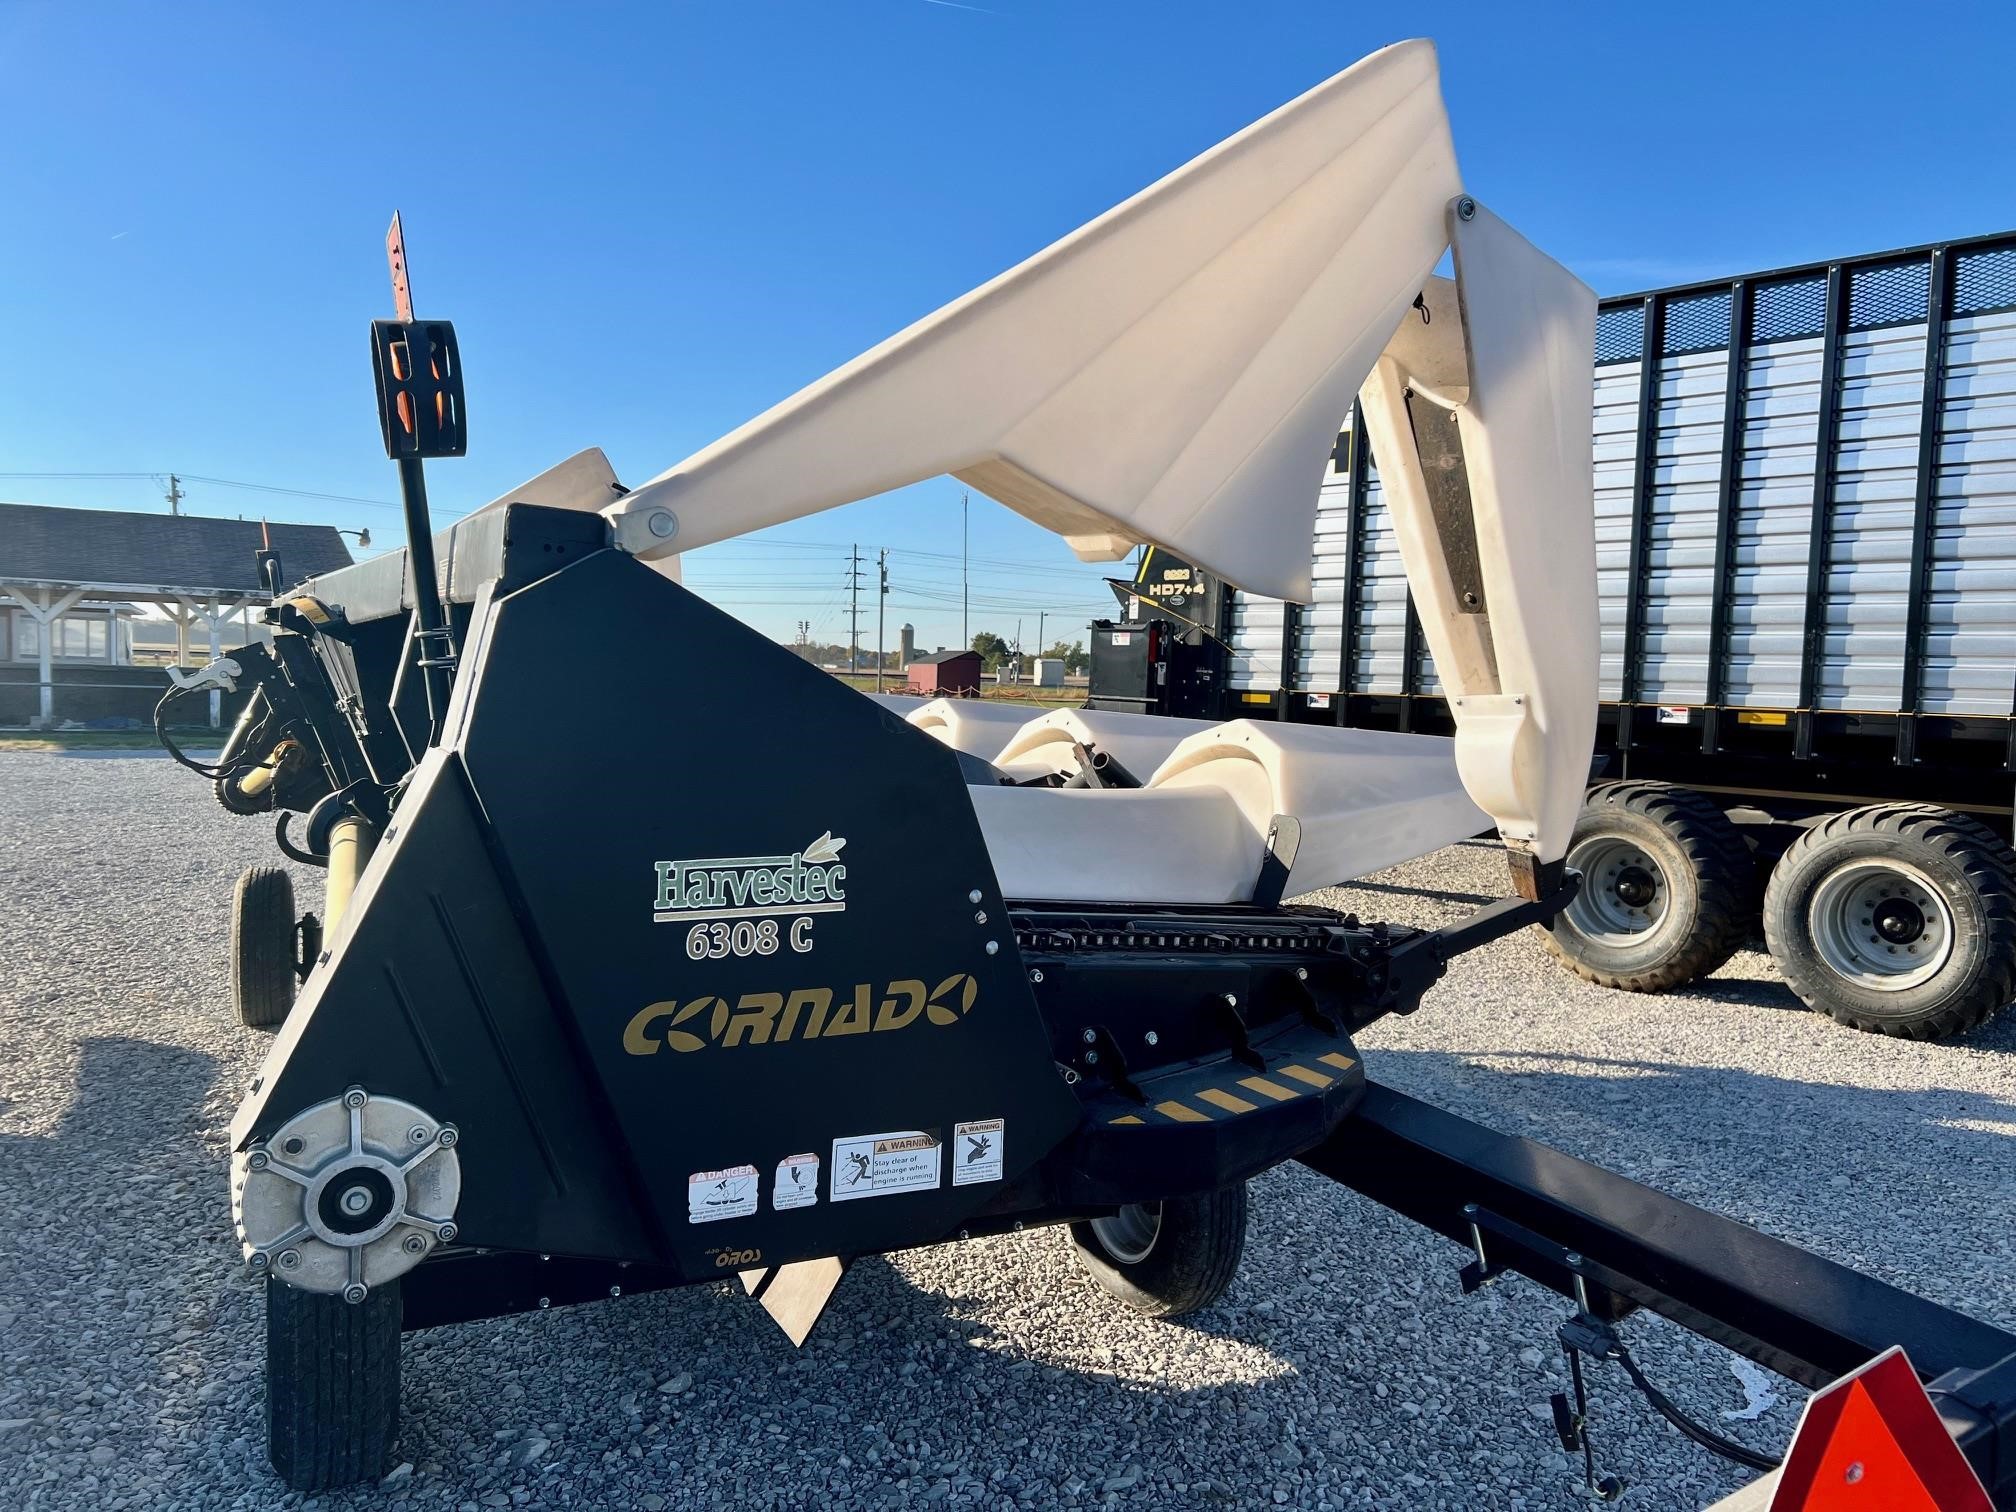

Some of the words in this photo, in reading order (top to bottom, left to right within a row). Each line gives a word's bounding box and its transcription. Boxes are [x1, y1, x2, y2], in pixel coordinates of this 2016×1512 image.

[1149, 583, 1205, 596] HD7+4
[654, 853, 846, 909] Harvestec
[686, 919, 779, 960] 6308
[790, 917, 814, 952] C
[622, 973, 978, 1056] CORNADO
[968, 1123, 1000, 1132] WARNING
[874, 1159, 890, 1167] Stay
[891, 1157, 908, 1165] clear
[909, 1155, 918, 1163] of
[708, 1166, 754, 1179] DANGER
[874, 1166, 908, 1176] discharge
[909, 1164, 928, 1172] when
[873, 1177, 898, 1186] engine
[906, 1172, 933, 1181] running
